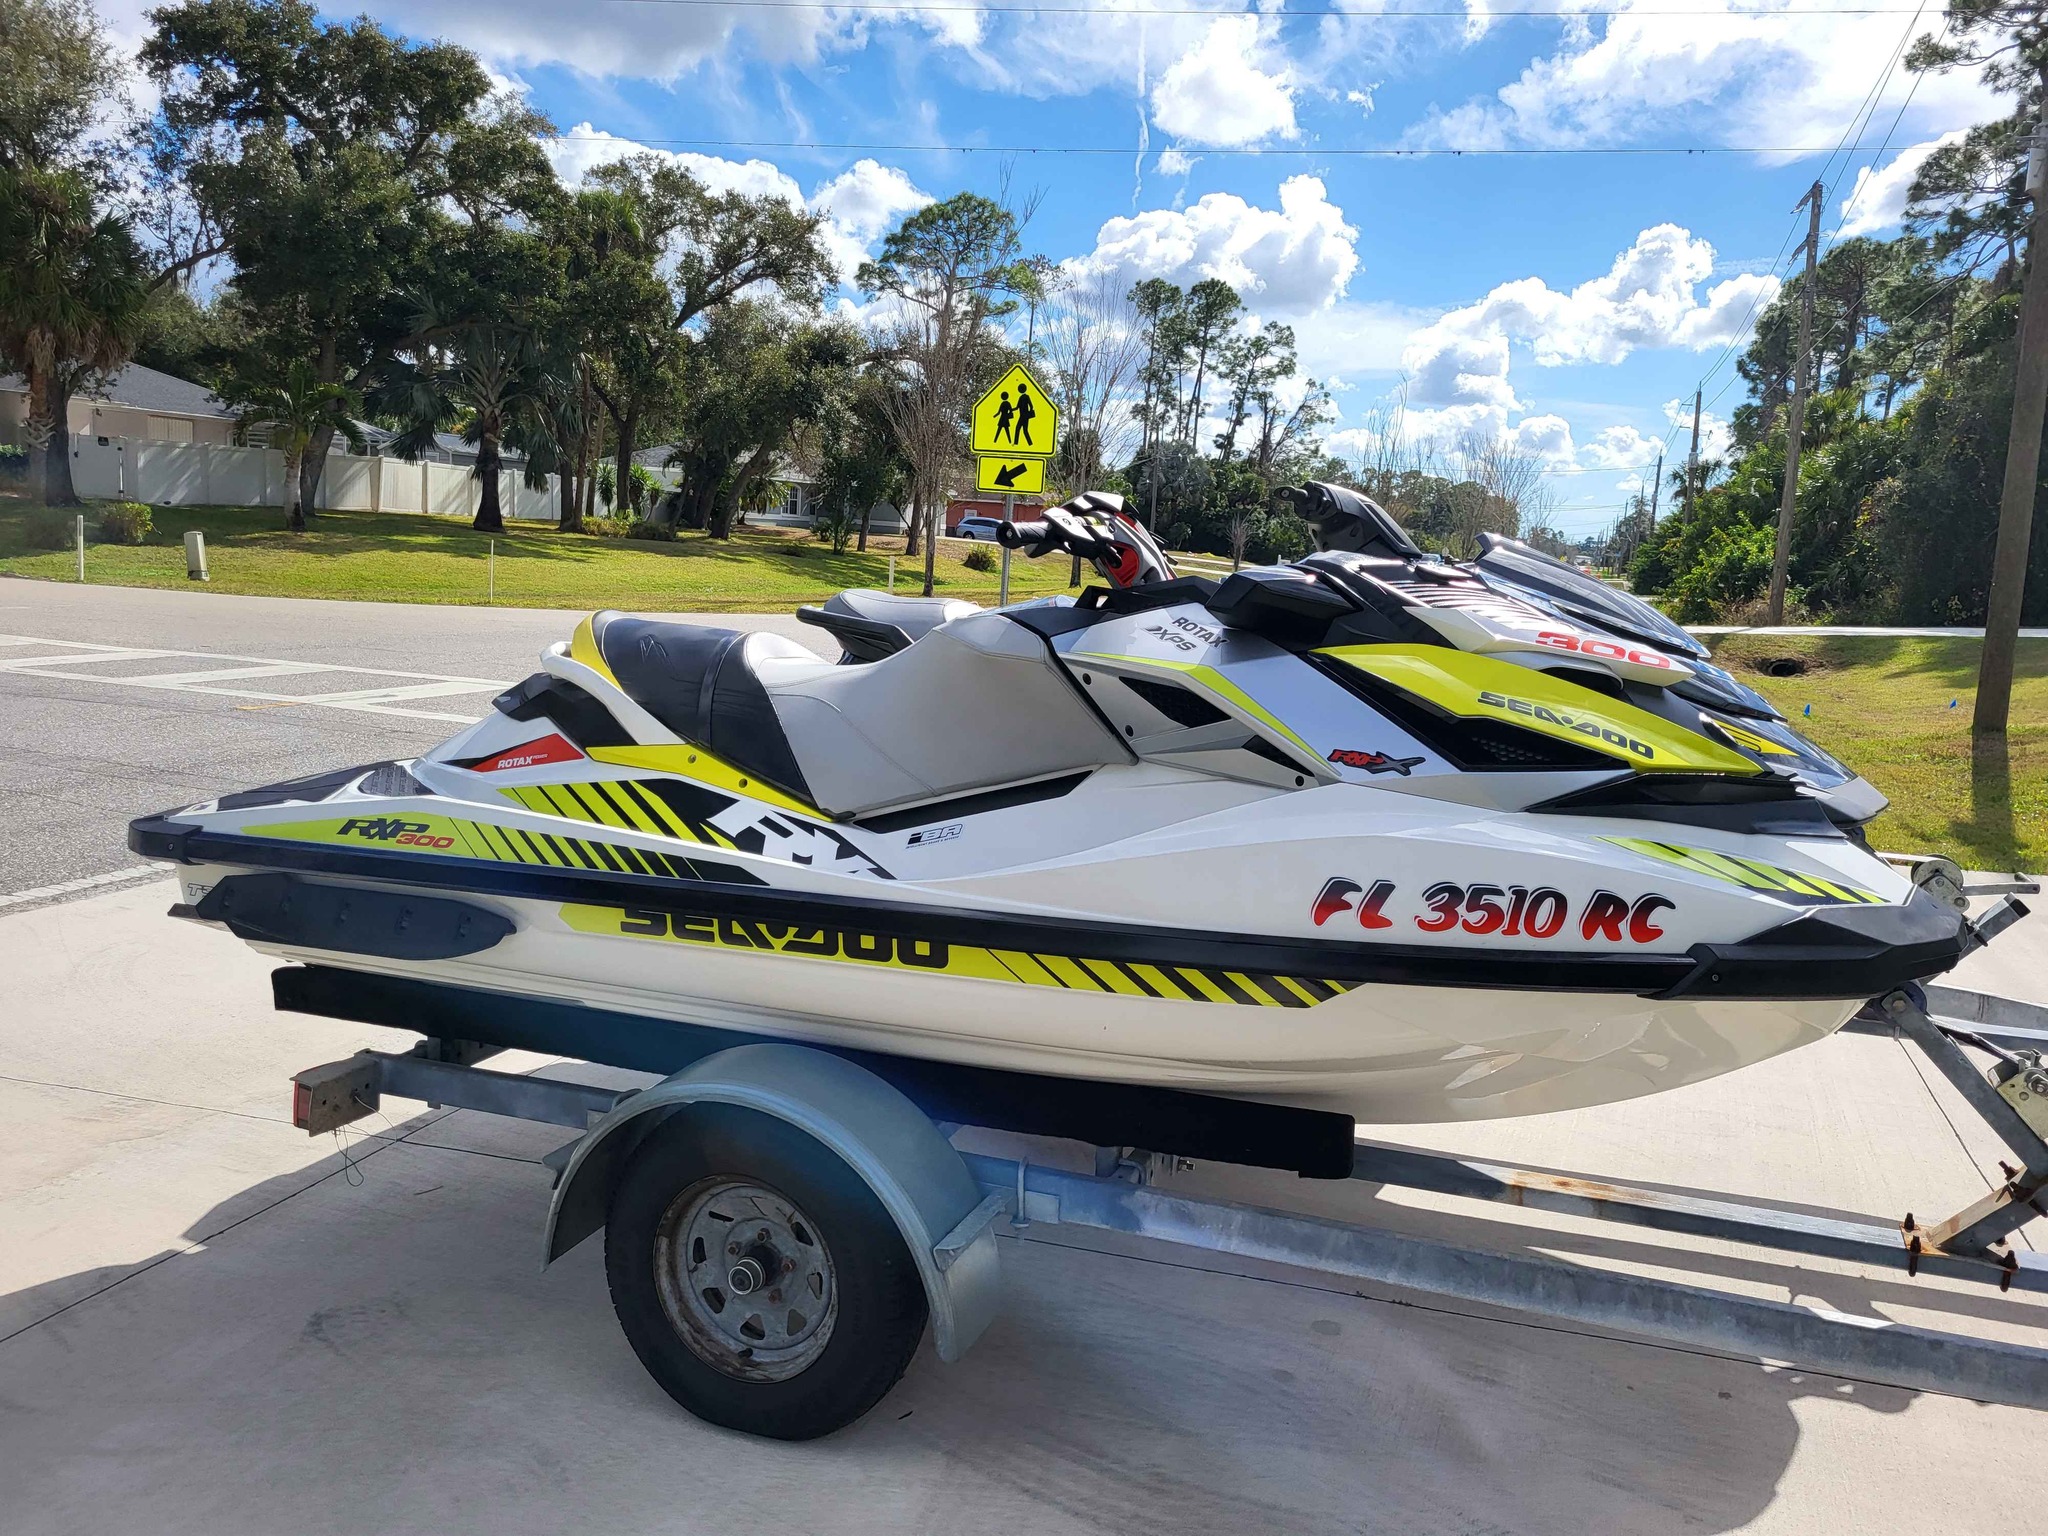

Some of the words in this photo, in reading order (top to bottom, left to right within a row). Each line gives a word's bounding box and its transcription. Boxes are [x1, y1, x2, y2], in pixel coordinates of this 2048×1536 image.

[1145, 626, 1197, 651] XPS
[1172, 616, 1228, 648] ROTAX
[1535, 631, 1671, 669] 300
[497, 756, 533, 769] ROTAX
[336, 817, 431, 840] RXP
[395, 833, 455, 849] 300
[1310, 876, 1398, 929] FL
[1413, 881, 1569, 939] 3510
[1579, 889, 1677, 944] RC
